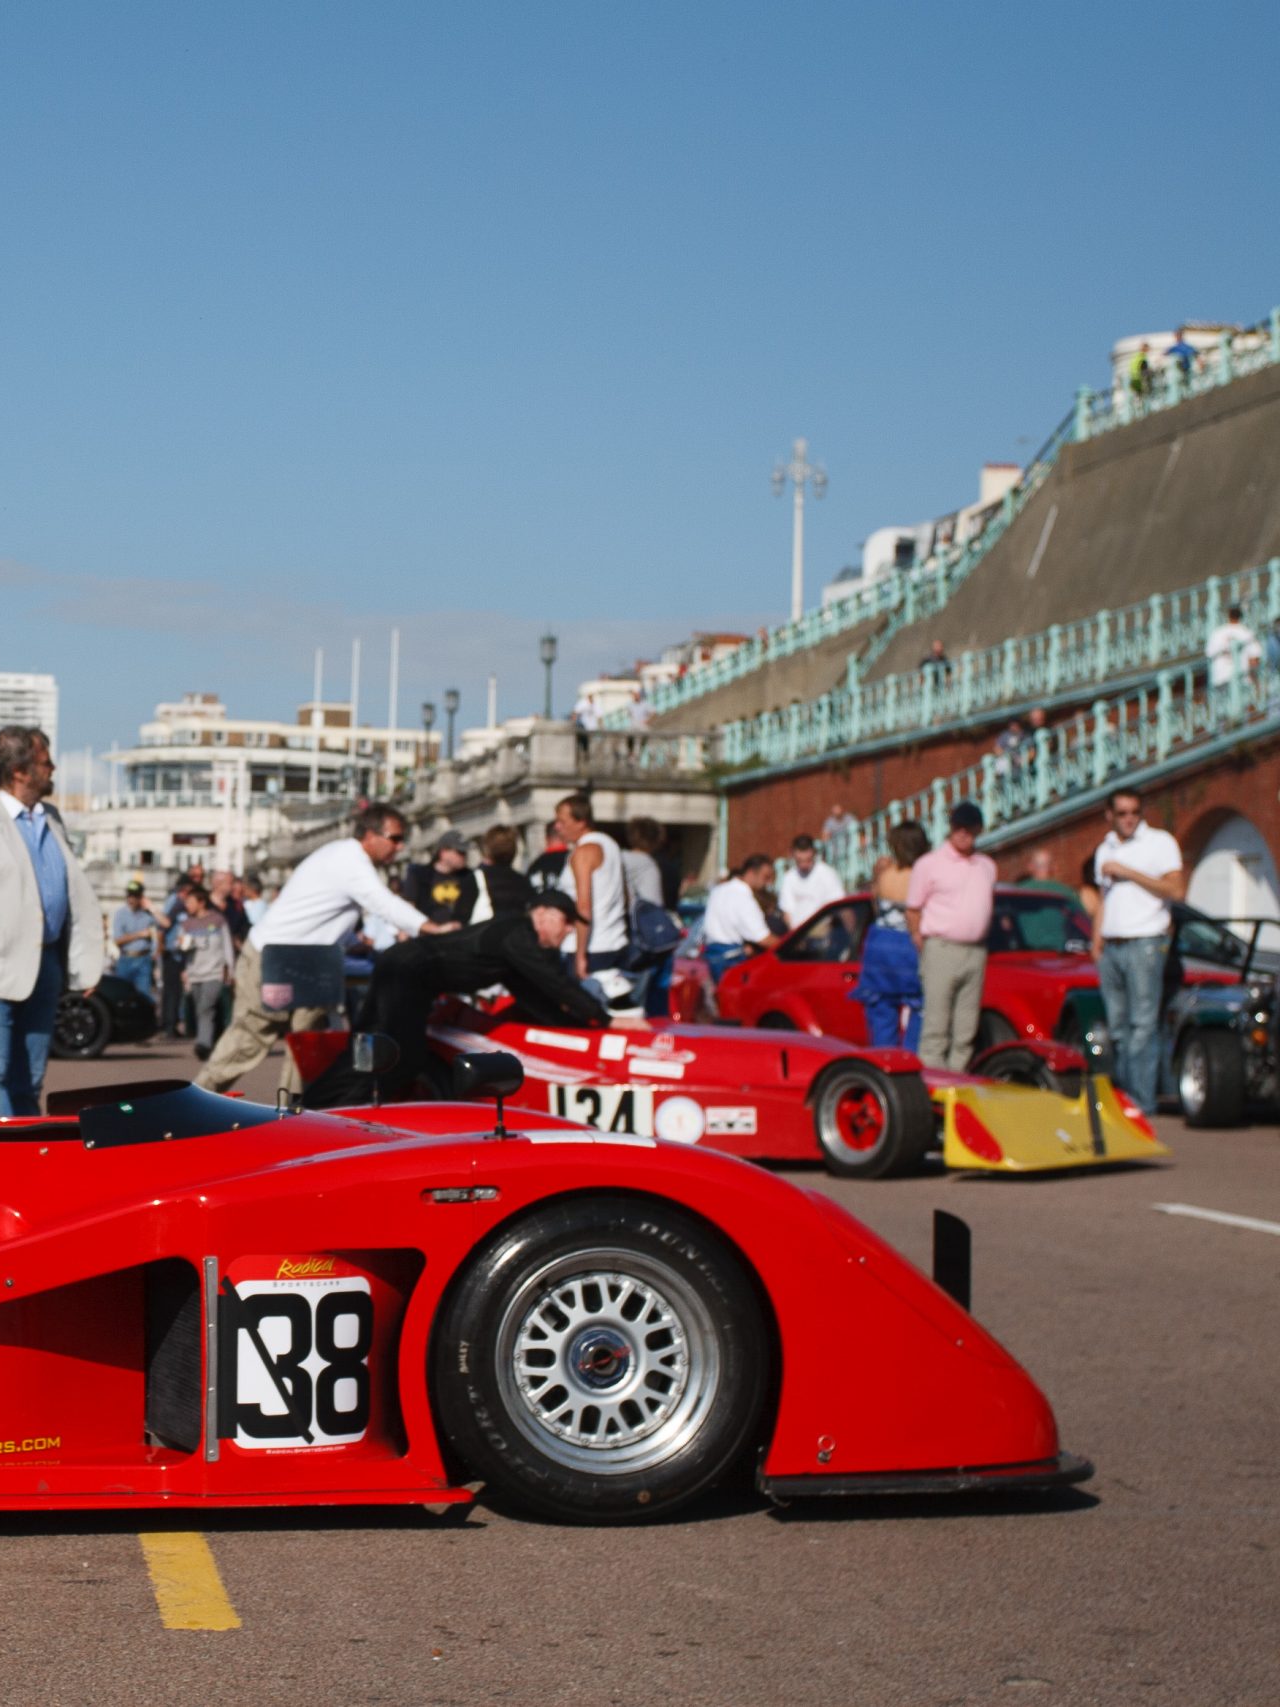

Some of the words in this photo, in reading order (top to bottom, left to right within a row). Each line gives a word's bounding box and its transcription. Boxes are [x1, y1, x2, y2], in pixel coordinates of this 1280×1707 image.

[556, 1086, 635, 1136] 134
[276, 1257, 337, 1279] Radical
[225, 1292, 374, 1440] 38
